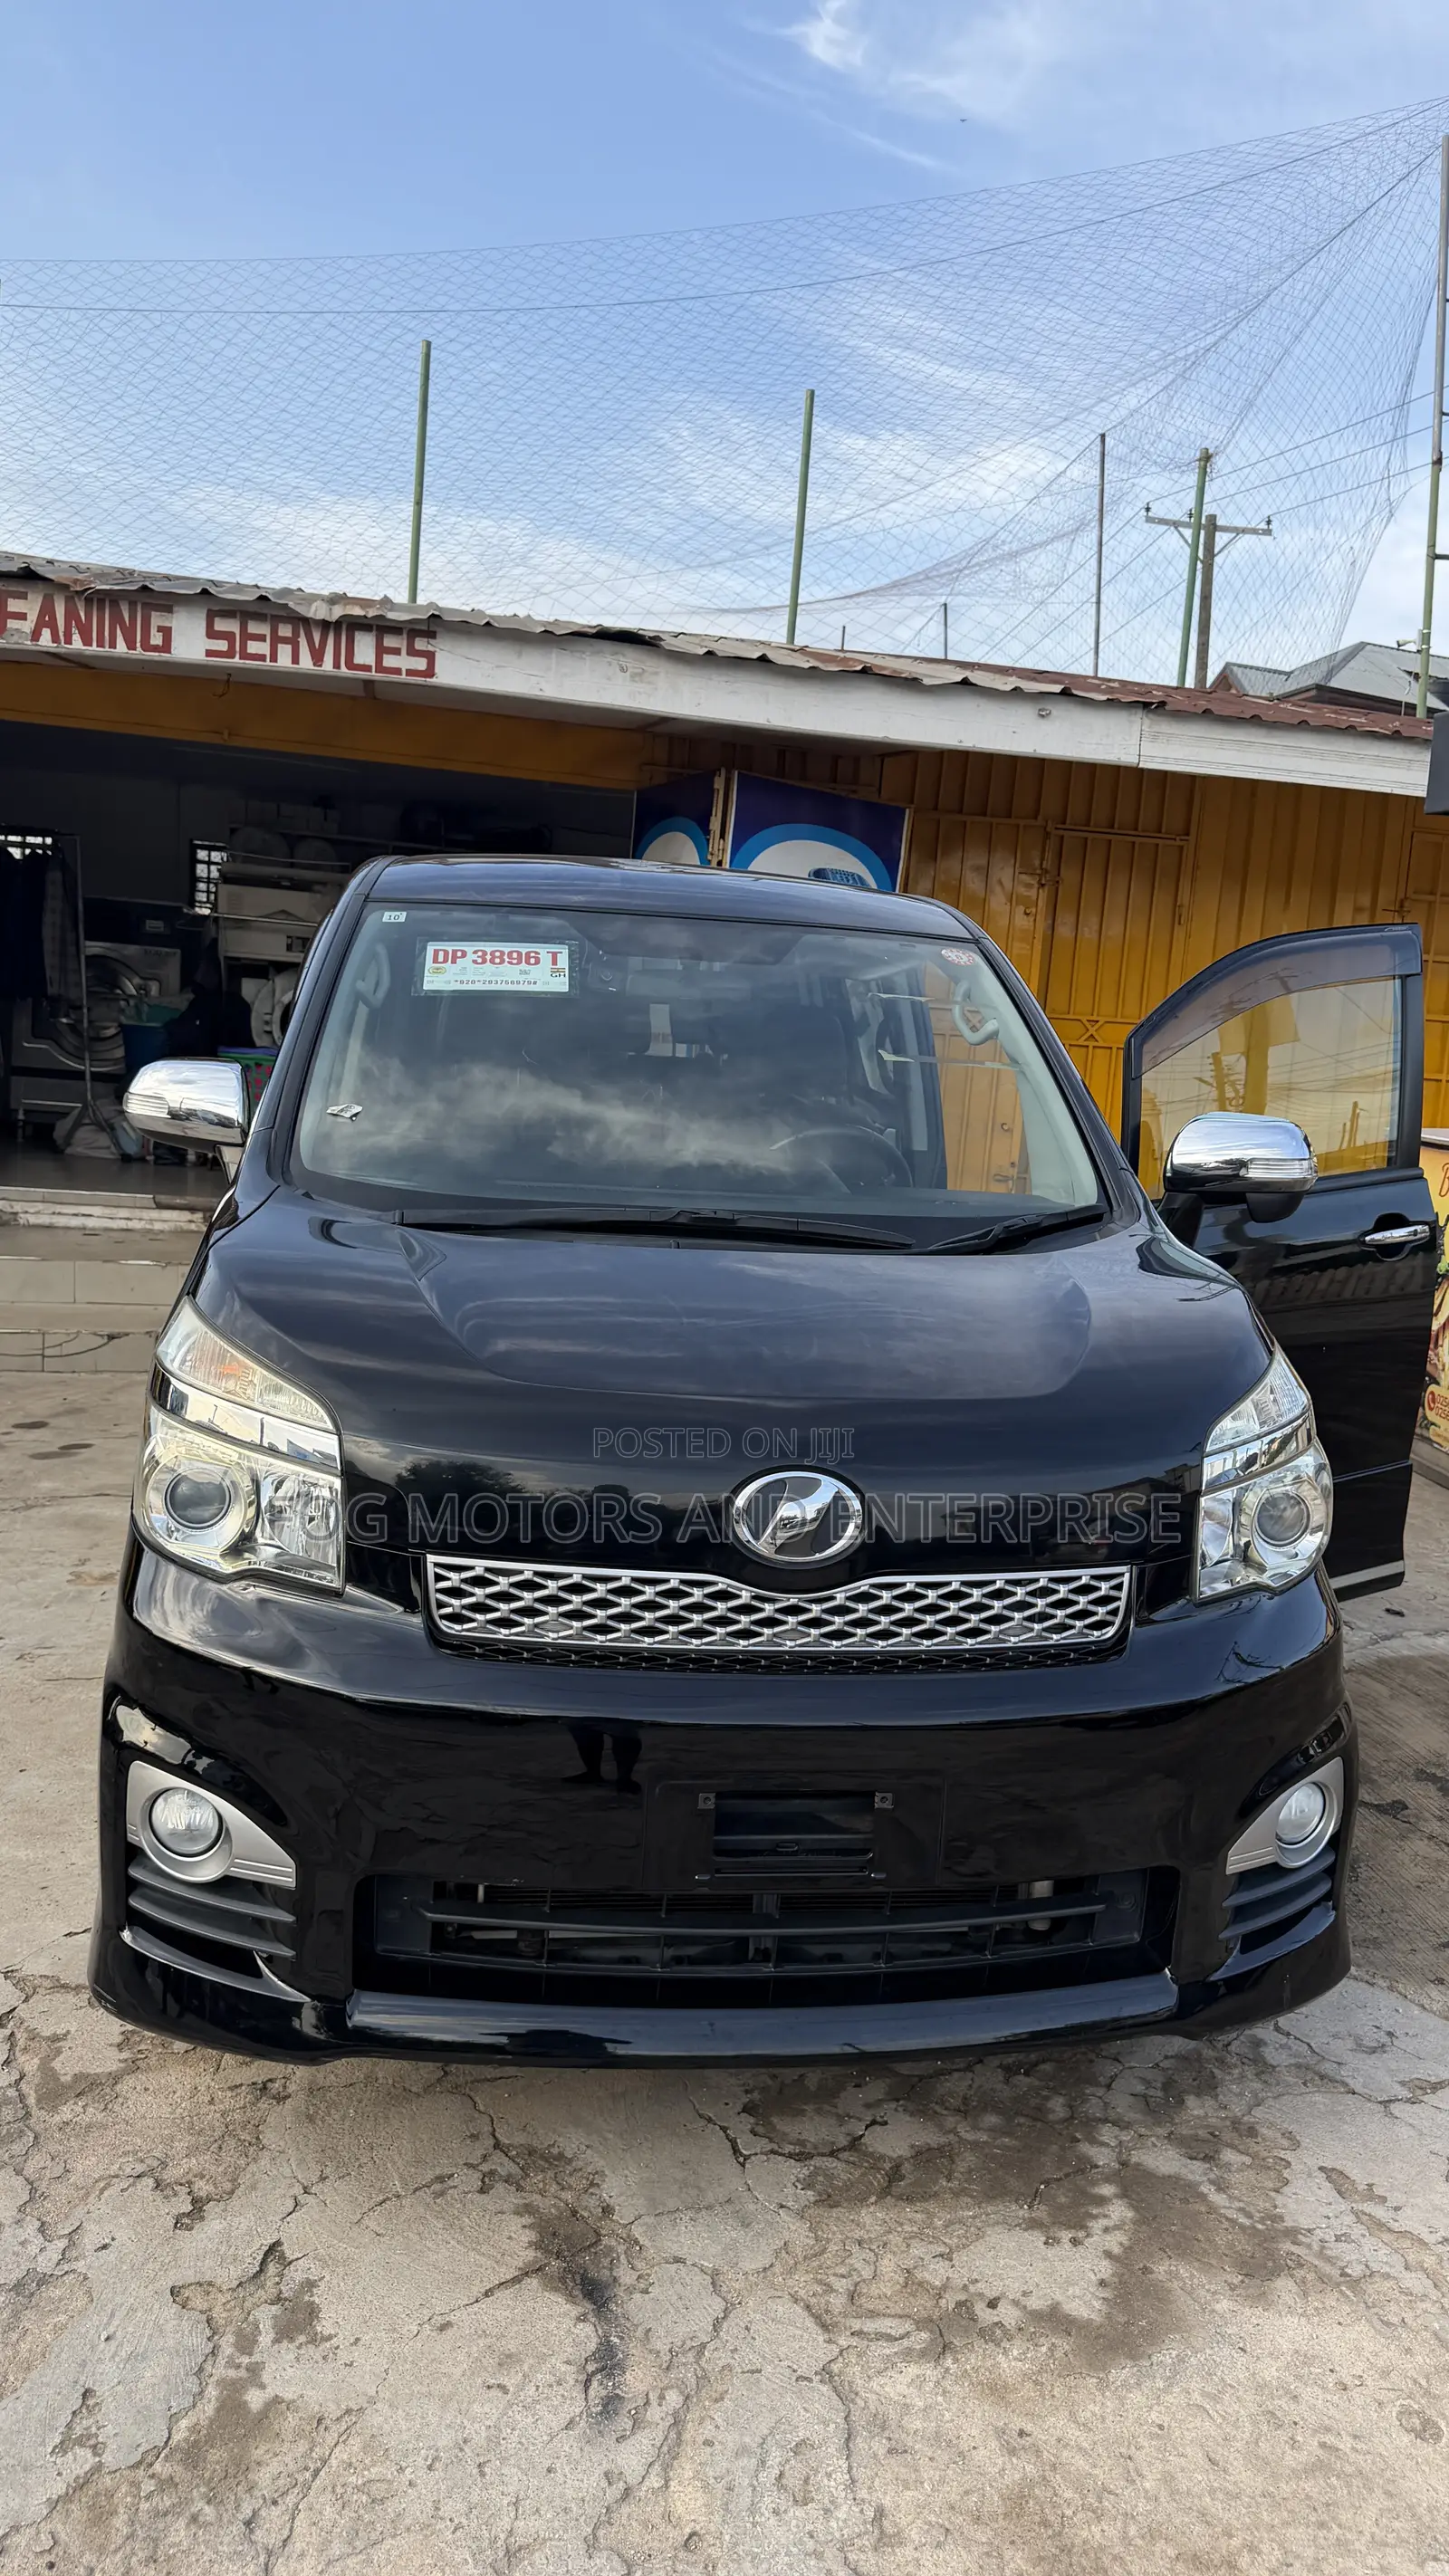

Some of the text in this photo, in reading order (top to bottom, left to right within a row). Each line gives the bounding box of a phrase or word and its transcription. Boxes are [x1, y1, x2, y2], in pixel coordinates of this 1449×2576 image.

[205, 608, 437, 679] SERVICES
[432, 948, 563, 966] DP 3896 T
